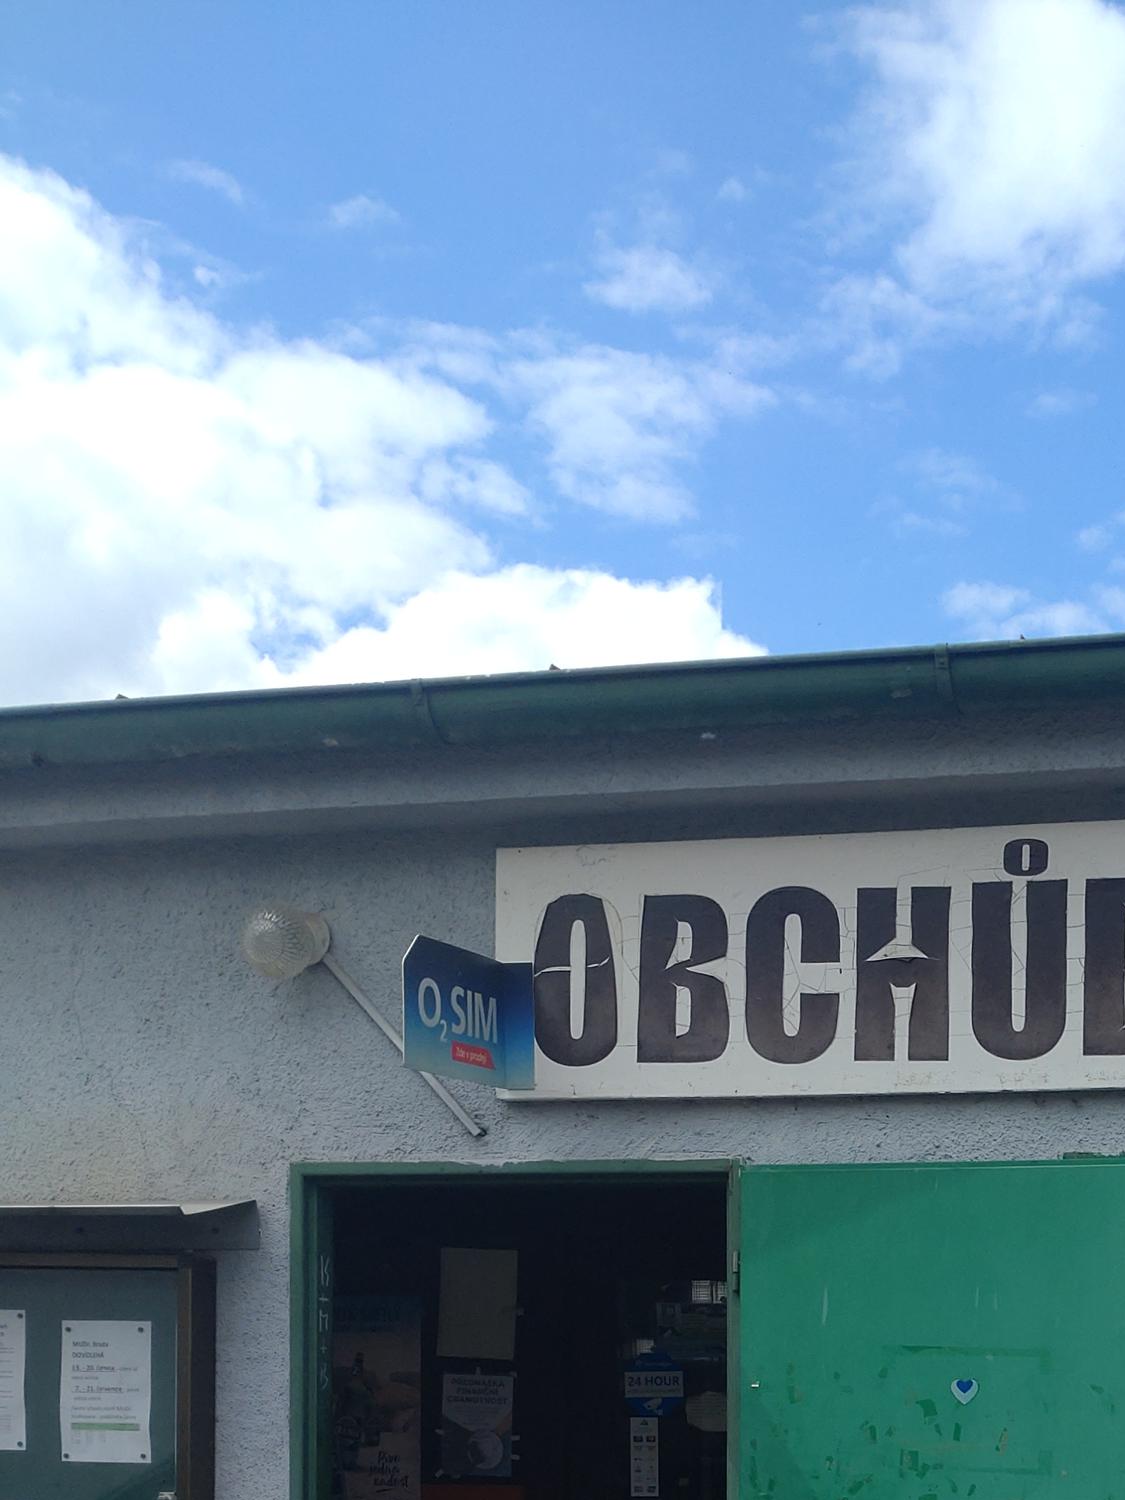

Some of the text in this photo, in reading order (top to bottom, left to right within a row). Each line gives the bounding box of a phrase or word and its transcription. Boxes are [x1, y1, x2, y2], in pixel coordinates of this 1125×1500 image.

[450, 985, 498, 1044] SIM
[627, 1375, 680, 1387] 24 HOUR
